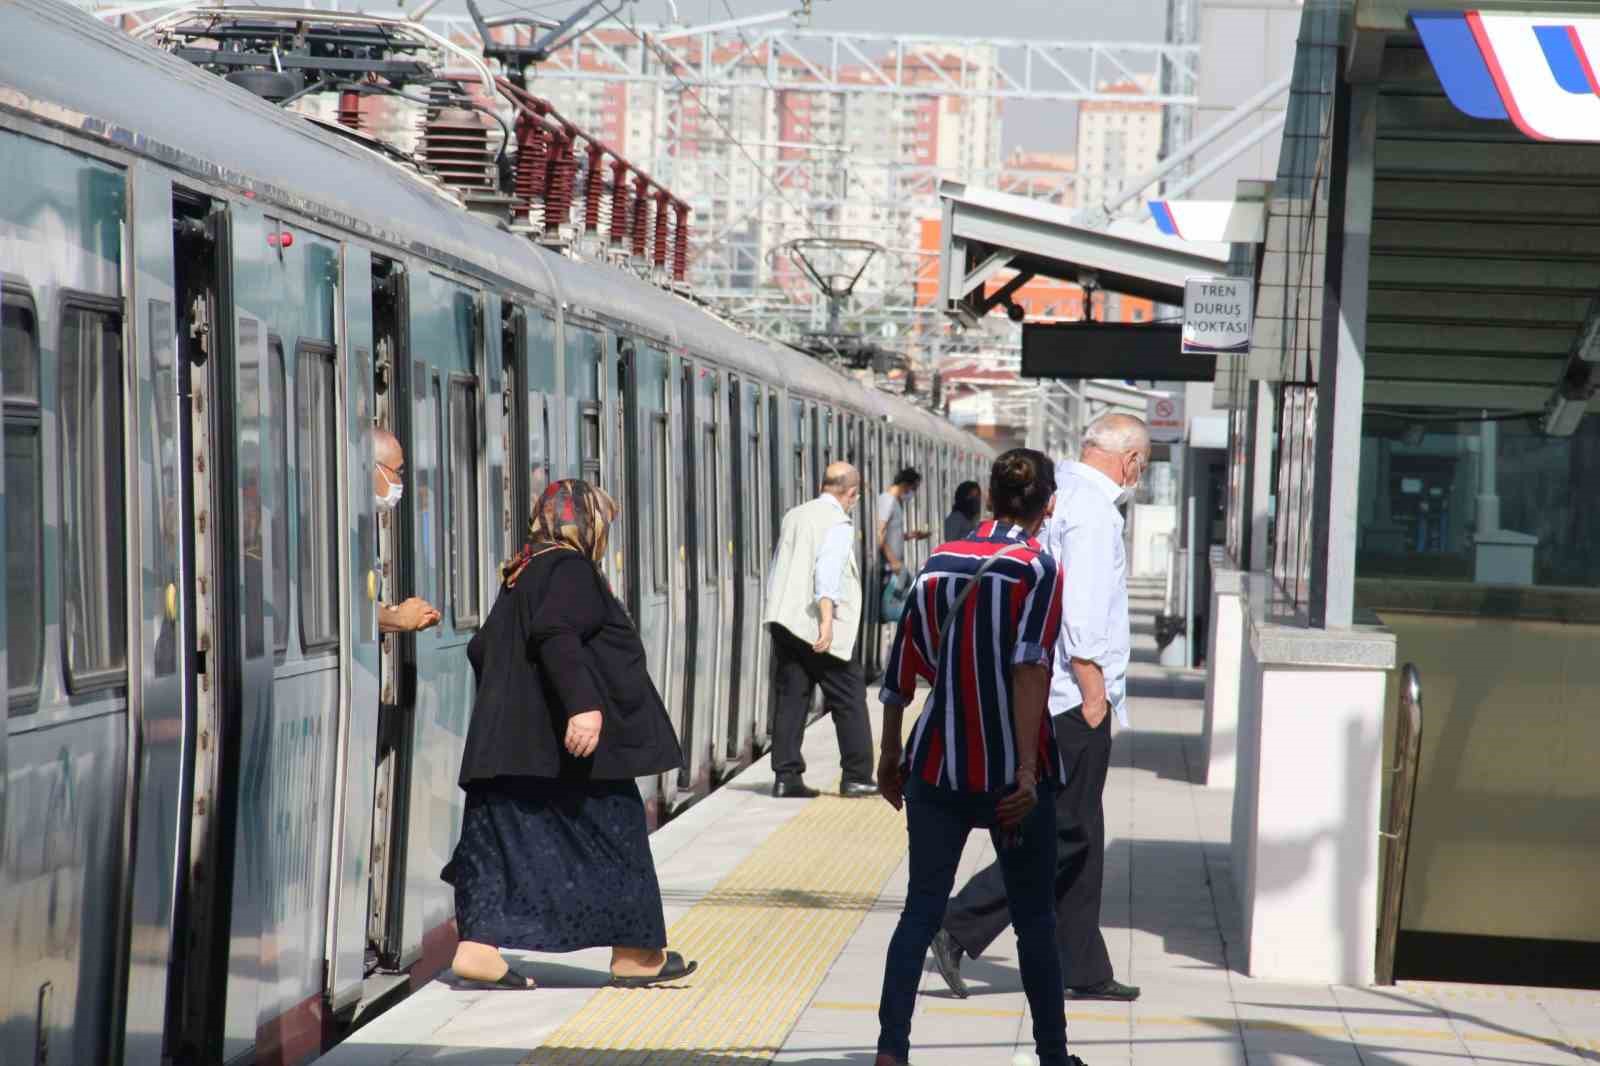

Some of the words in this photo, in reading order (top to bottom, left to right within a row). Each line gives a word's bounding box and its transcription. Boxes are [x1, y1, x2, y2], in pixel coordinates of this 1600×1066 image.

[1200, 285, 1236, 297] TREN
[1194, 303, 1241, 317] DURUŞ
[1186, 321, 1247, 333] NOKTASI
